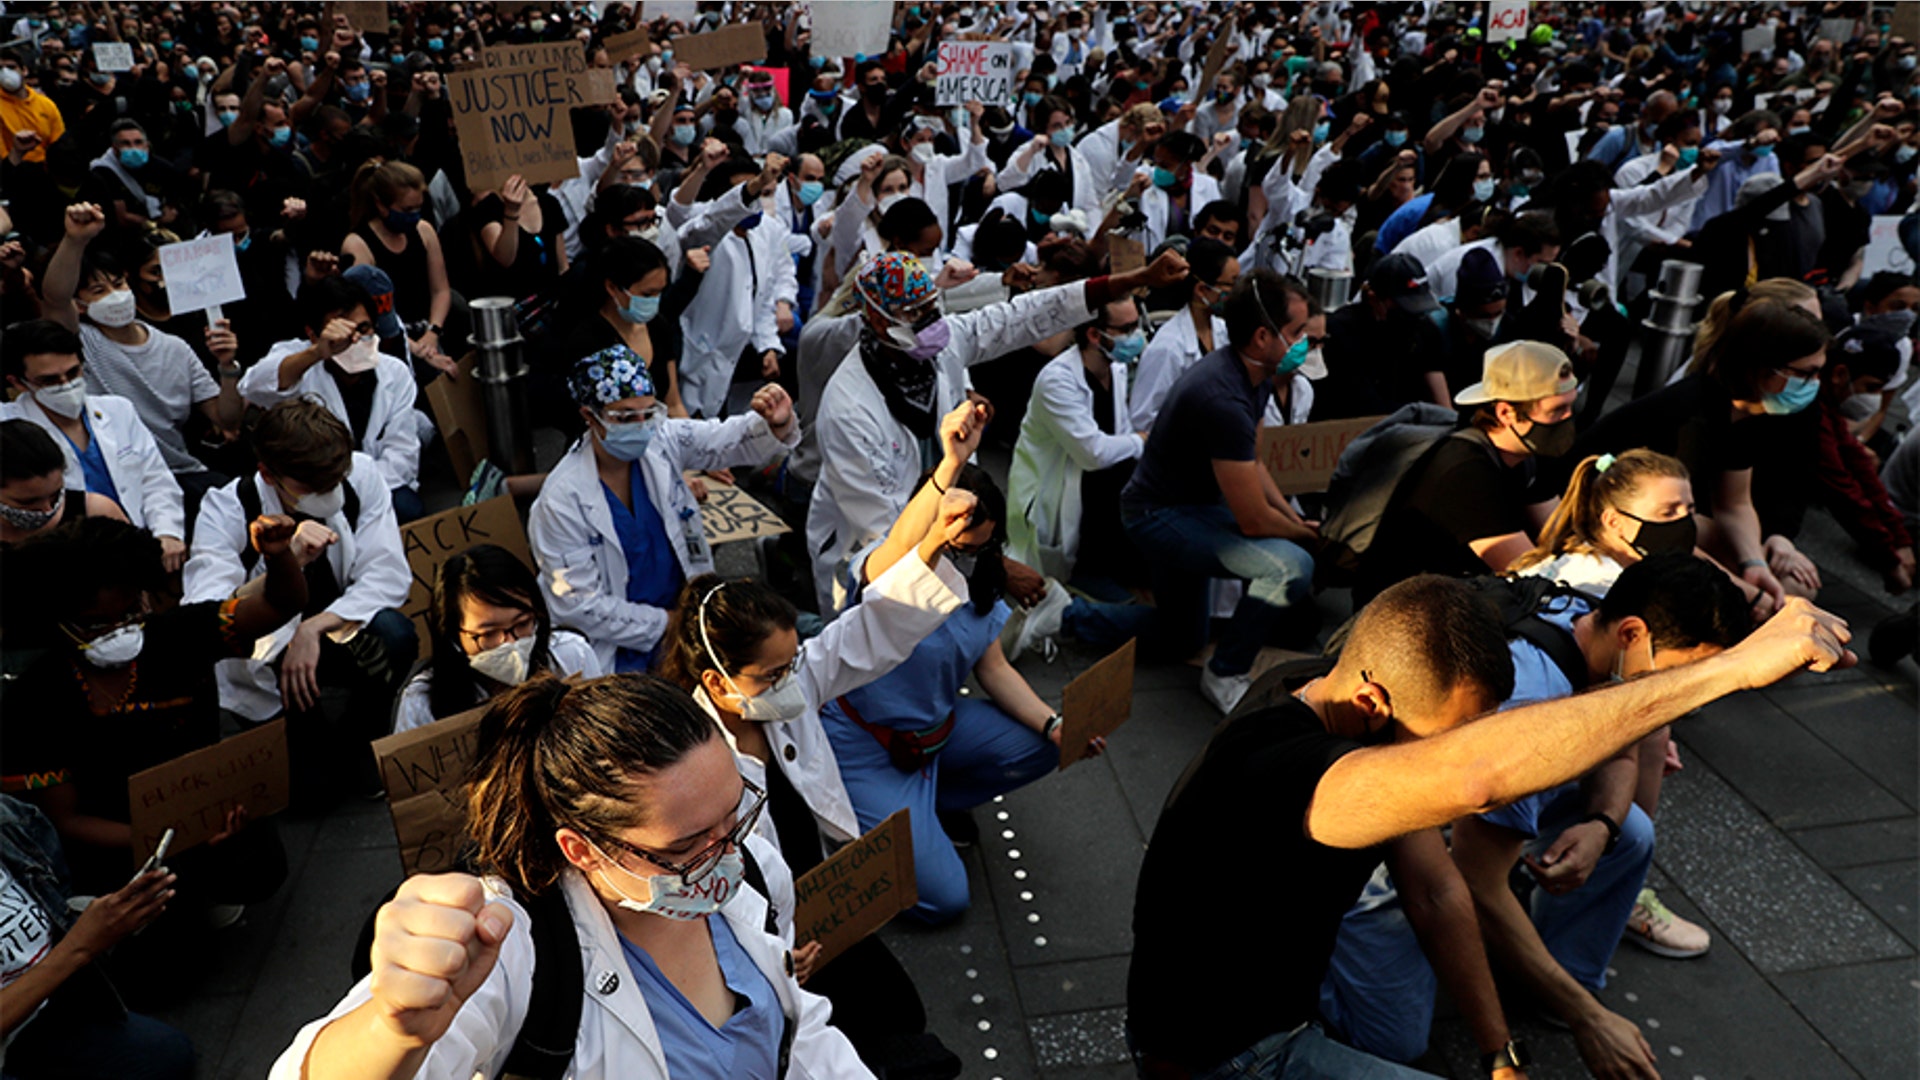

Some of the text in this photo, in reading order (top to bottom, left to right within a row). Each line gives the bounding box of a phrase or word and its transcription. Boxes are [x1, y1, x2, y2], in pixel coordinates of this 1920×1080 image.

[936, 44, 1009, 76] SHAME ON
[456, 68, 565, 114] JUSTICE
[938, 76, 1009, 103] AMERICA
[491, 108, 554, 144] NOW
[1268, 430, 1352, 472] ACK LIV
[405, 510, 490, 555] ACK
[708, 489, 786, 534] ACK
[393, 733, 473, 792] WHI
[142, 772, 210, 808] BLACK
[846, 871, 893, 918] LIVES
